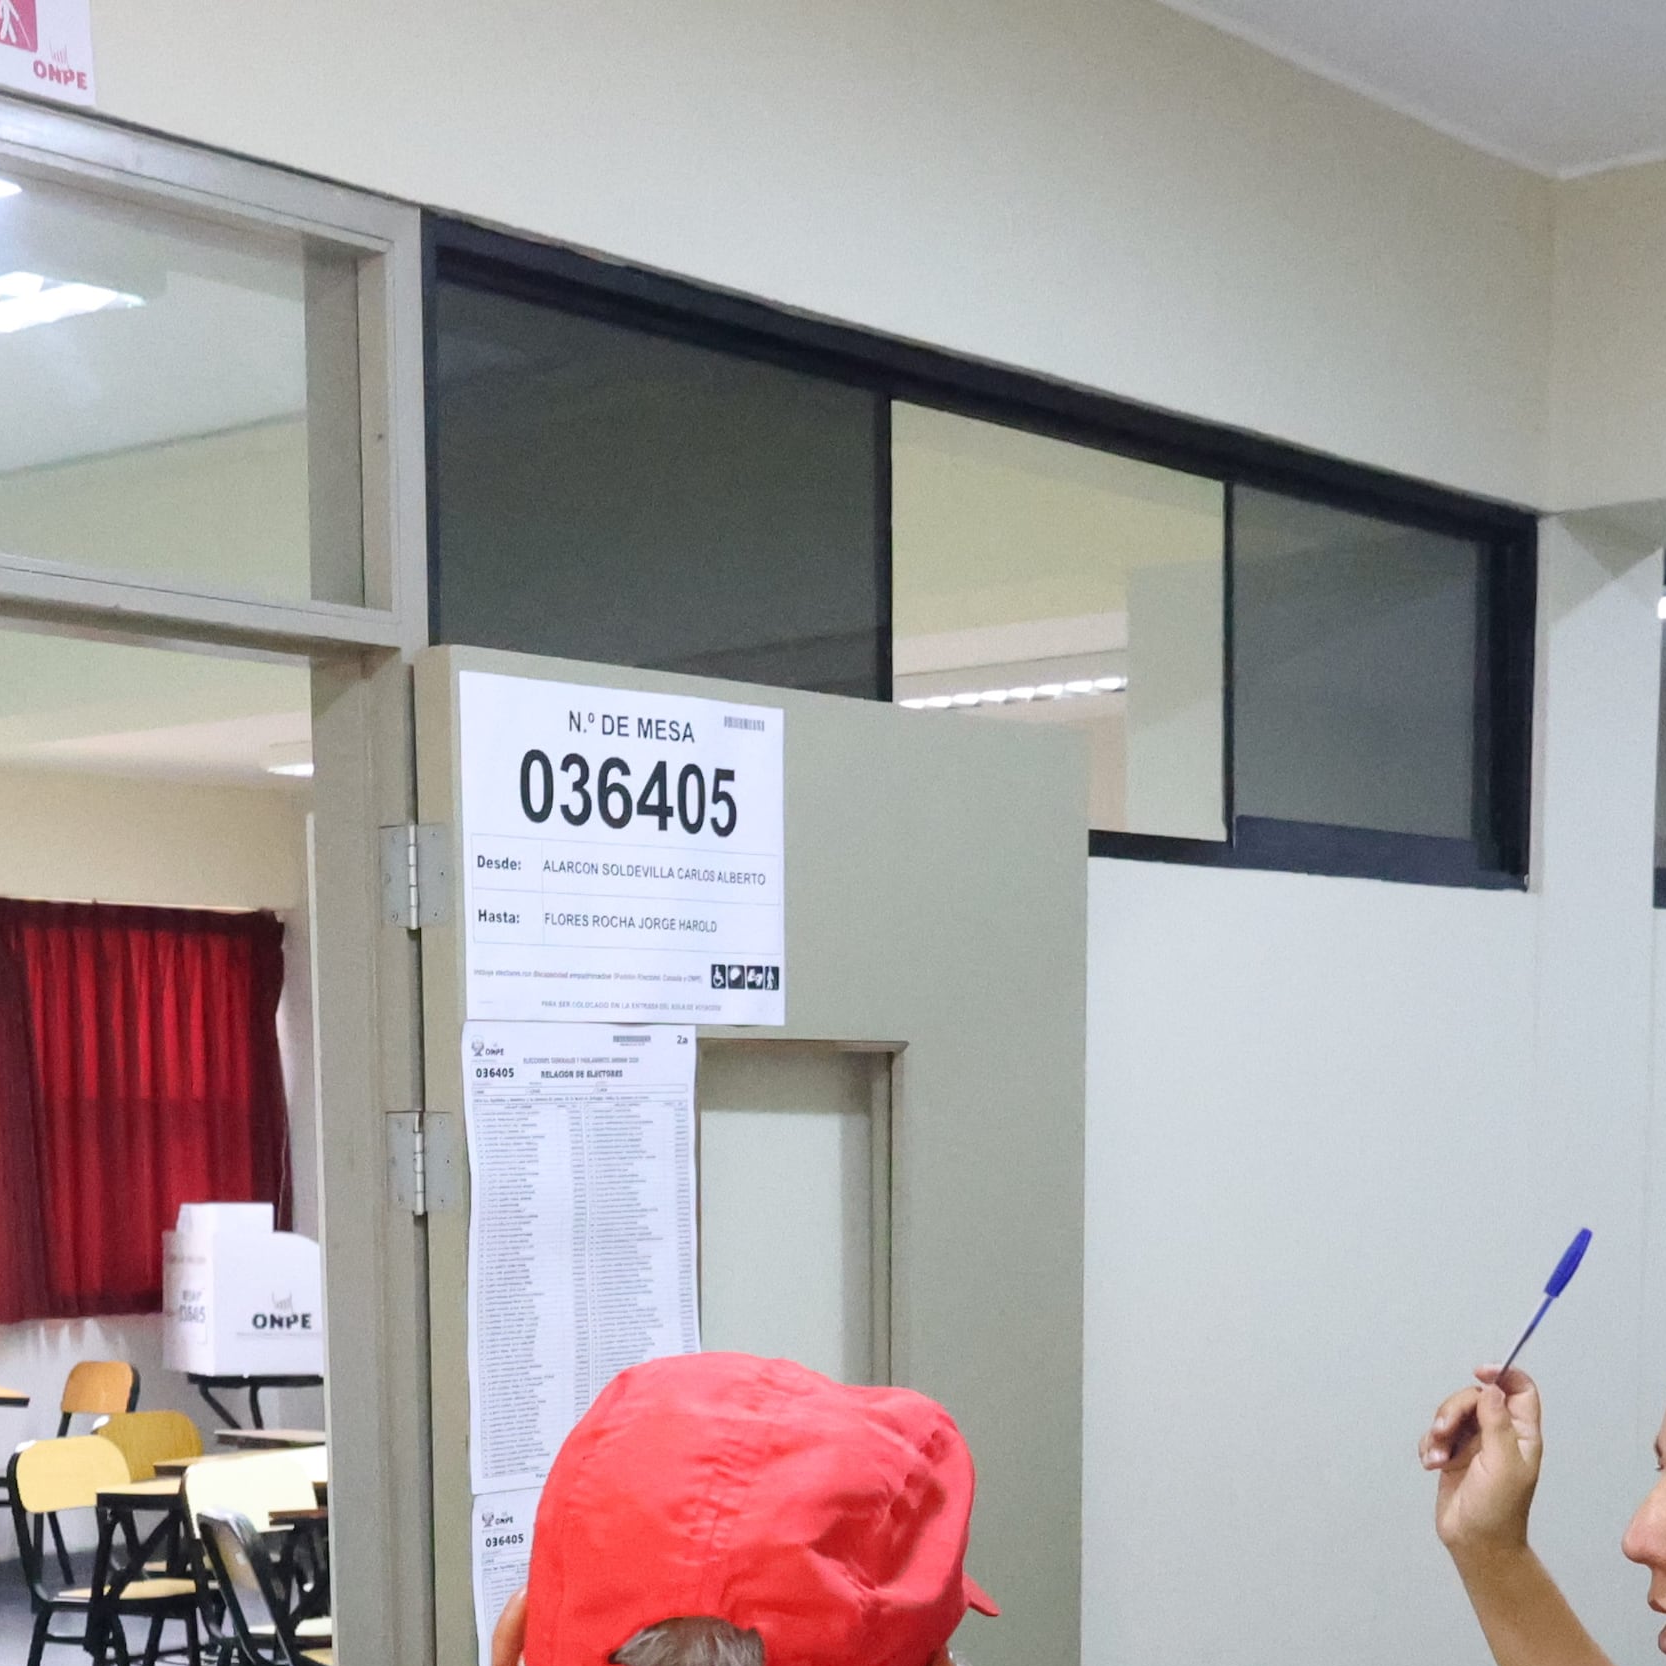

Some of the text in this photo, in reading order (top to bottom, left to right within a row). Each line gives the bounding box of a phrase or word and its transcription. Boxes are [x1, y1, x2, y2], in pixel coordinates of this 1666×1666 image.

[33, 60, 87, 90] ONPE
[602, 714, 629, 737] DE
[637, 717, 695, 743] MESA
[520, 749, 737, 837] 036405
[477, 855, 766, 886] Desde: ALARCON SOLDEVILLA CARLOS ALBERTO
[478, 909, 717, 933] Hasta: FLORES ROCHA JORGE HAROLD
[677, 1035, 688, 1044] 2a
[476, 1068, 514, 1078] 036405
[253, 1313, 312, 1329] ONPE
[485, 1533, 524, 1547] 036405
